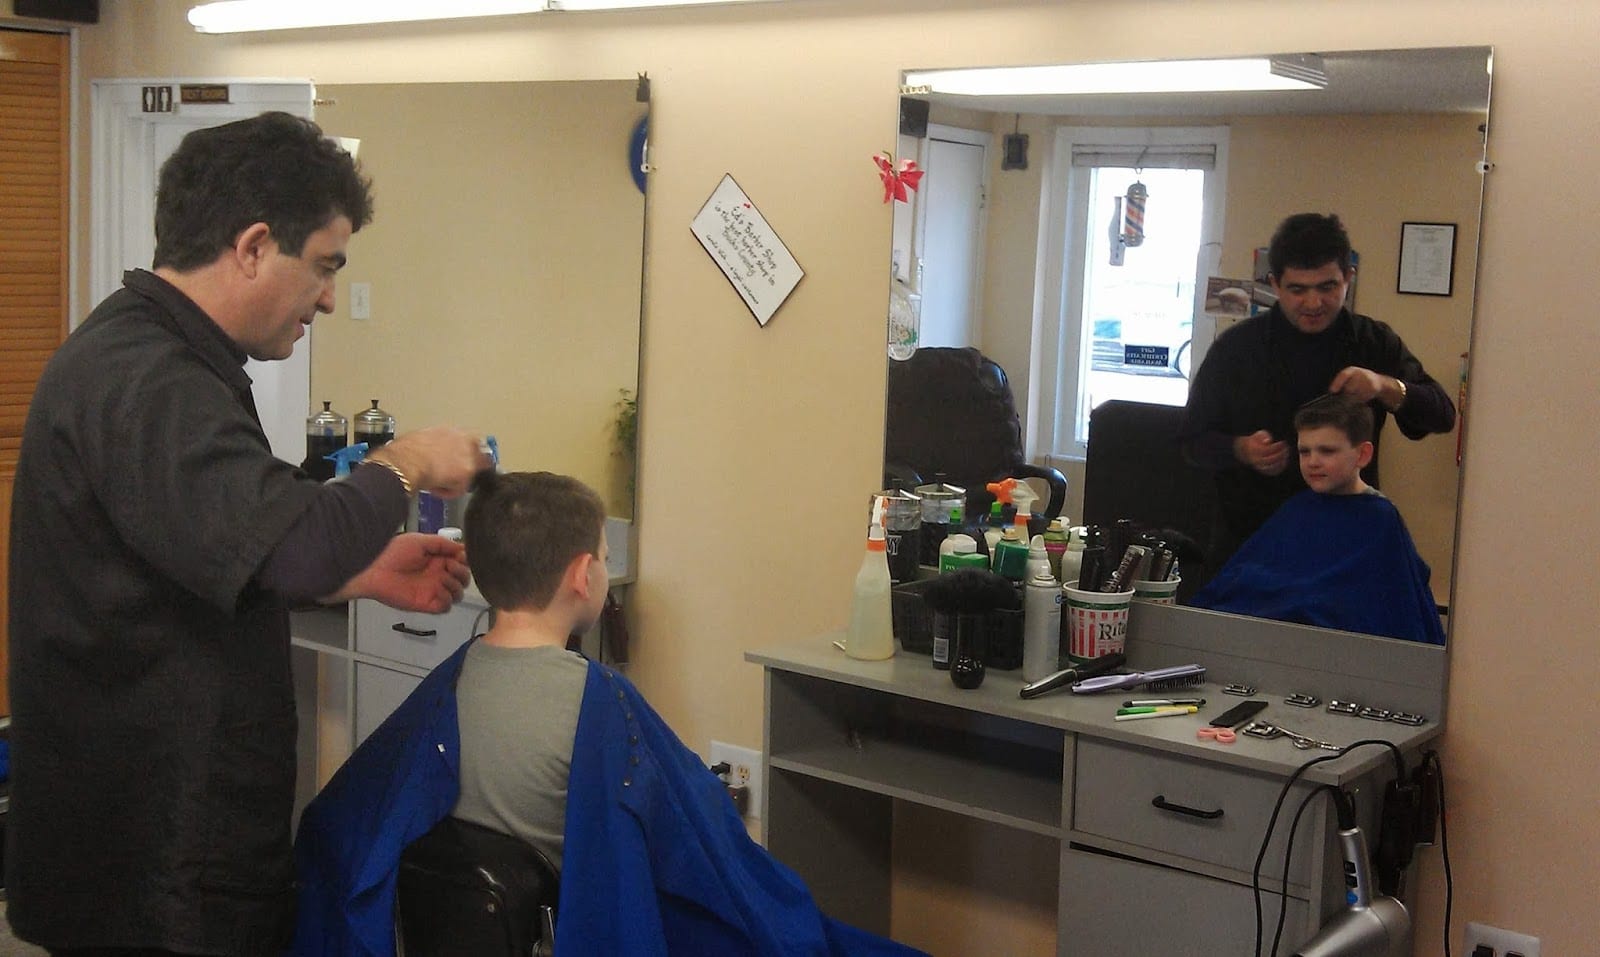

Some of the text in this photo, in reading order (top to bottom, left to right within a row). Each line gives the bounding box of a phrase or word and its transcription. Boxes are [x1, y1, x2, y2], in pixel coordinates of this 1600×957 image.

[740, 236, 758, 259] barber
[744, 222, 764, 249] Barber
[762, 249, 778, 270] Shop
